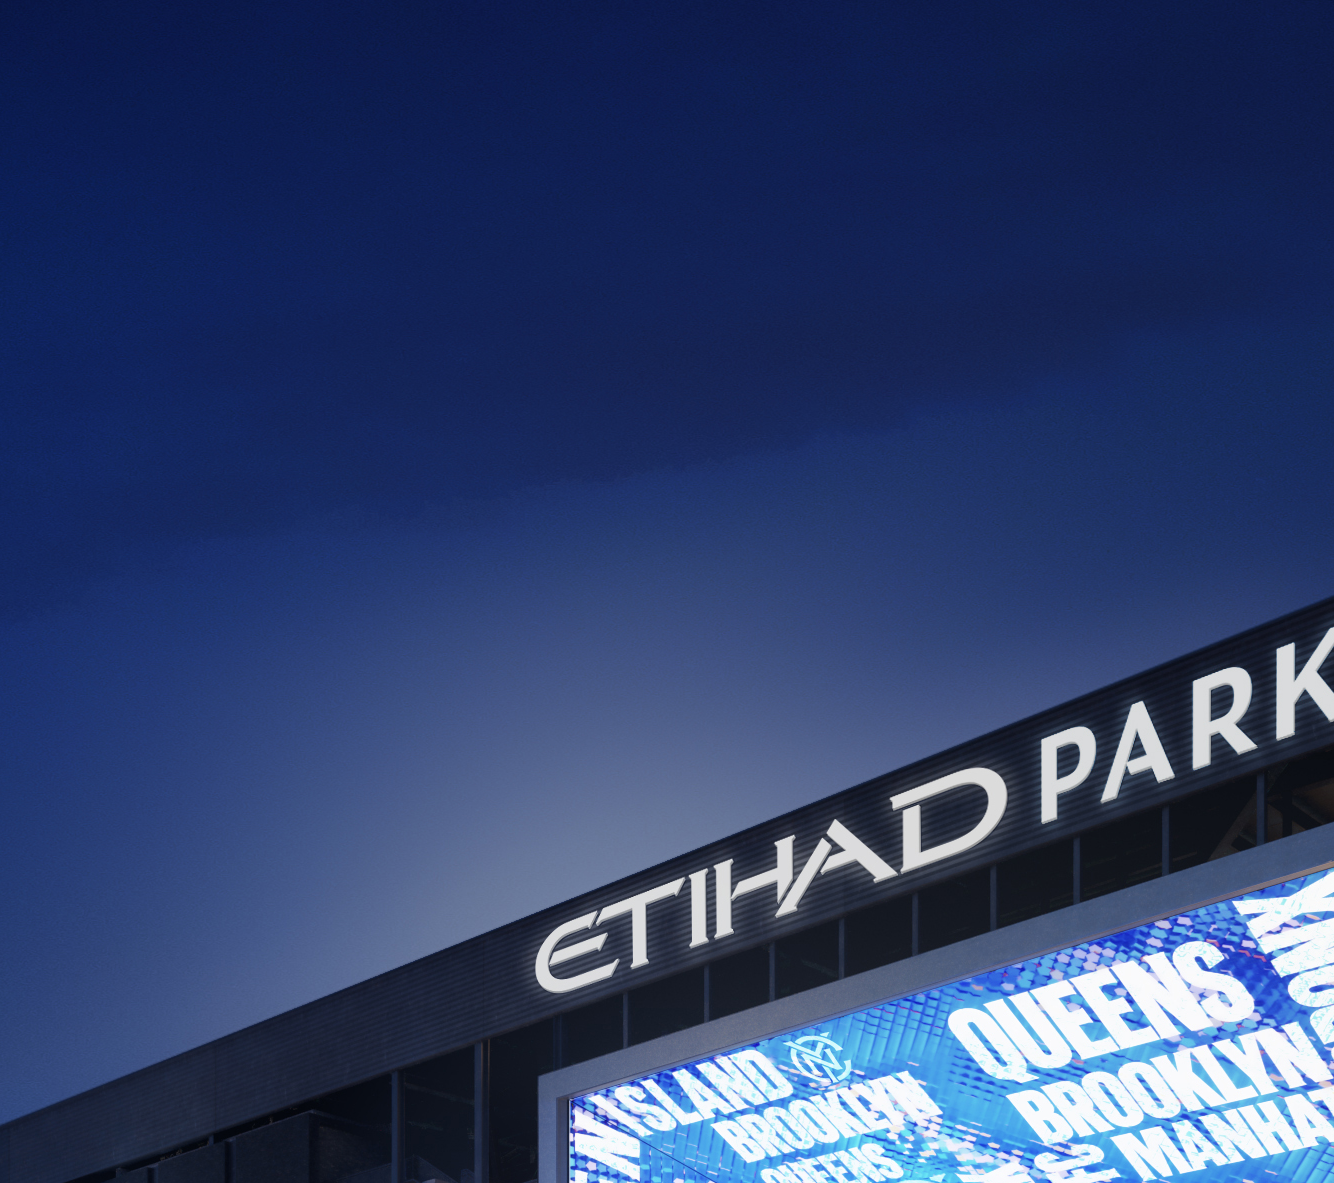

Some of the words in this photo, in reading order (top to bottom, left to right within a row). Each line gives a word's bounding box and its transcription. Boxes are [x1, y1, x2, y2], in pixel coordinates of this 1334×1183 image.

[535, 767, 1008, 994] ETIHAD
[947, 941, 1255, 1084] QUEENS
[588, 1049, 794, 1137] ISLAND
[710, 1070, 943, 1163] BROOKLYN
[1006, 1021, 1333, 1145] BROOKLYN
